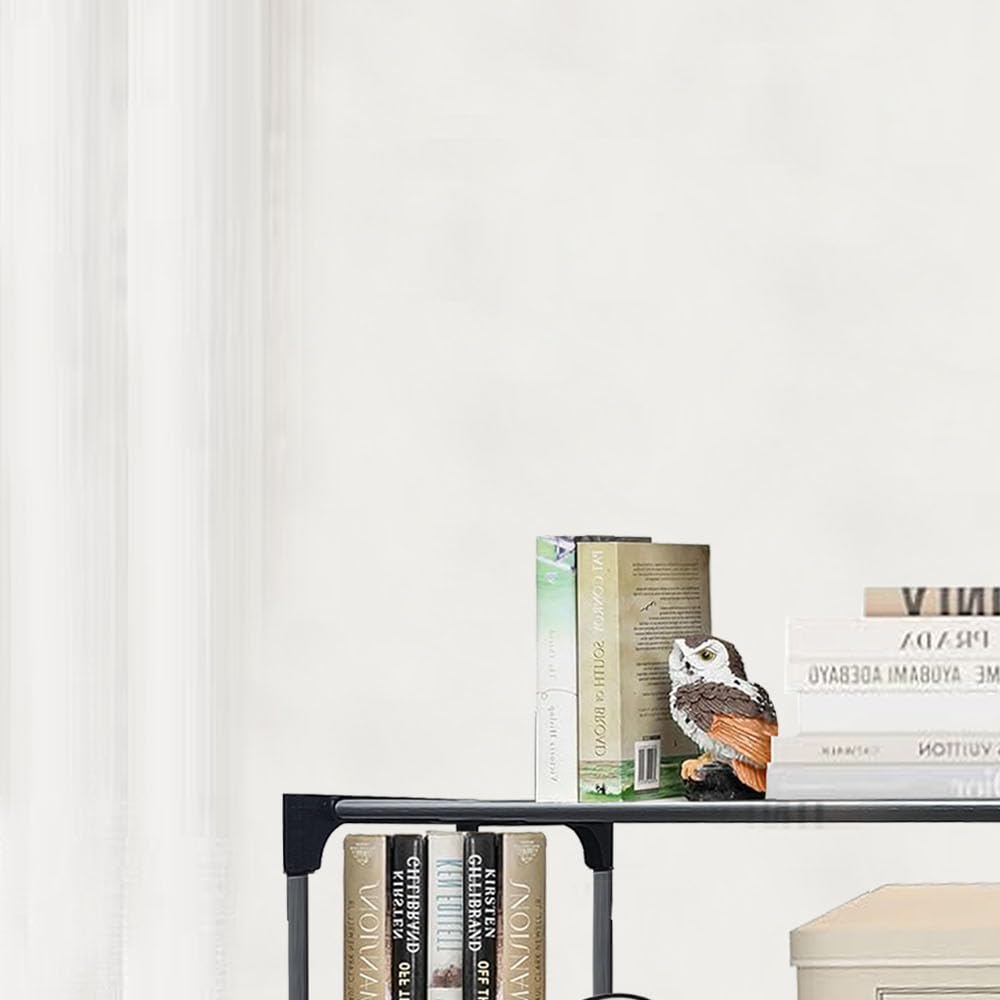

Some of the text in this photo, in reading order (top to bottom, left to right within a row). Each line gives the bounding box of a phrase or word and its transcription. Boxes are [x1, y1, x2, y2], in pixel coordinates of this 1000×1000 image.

[468, 854, 482, 952] GILLIBRAND
[484, 868, 496, 938] KIRSTEN
[477, 960, 490, 985] OFF
